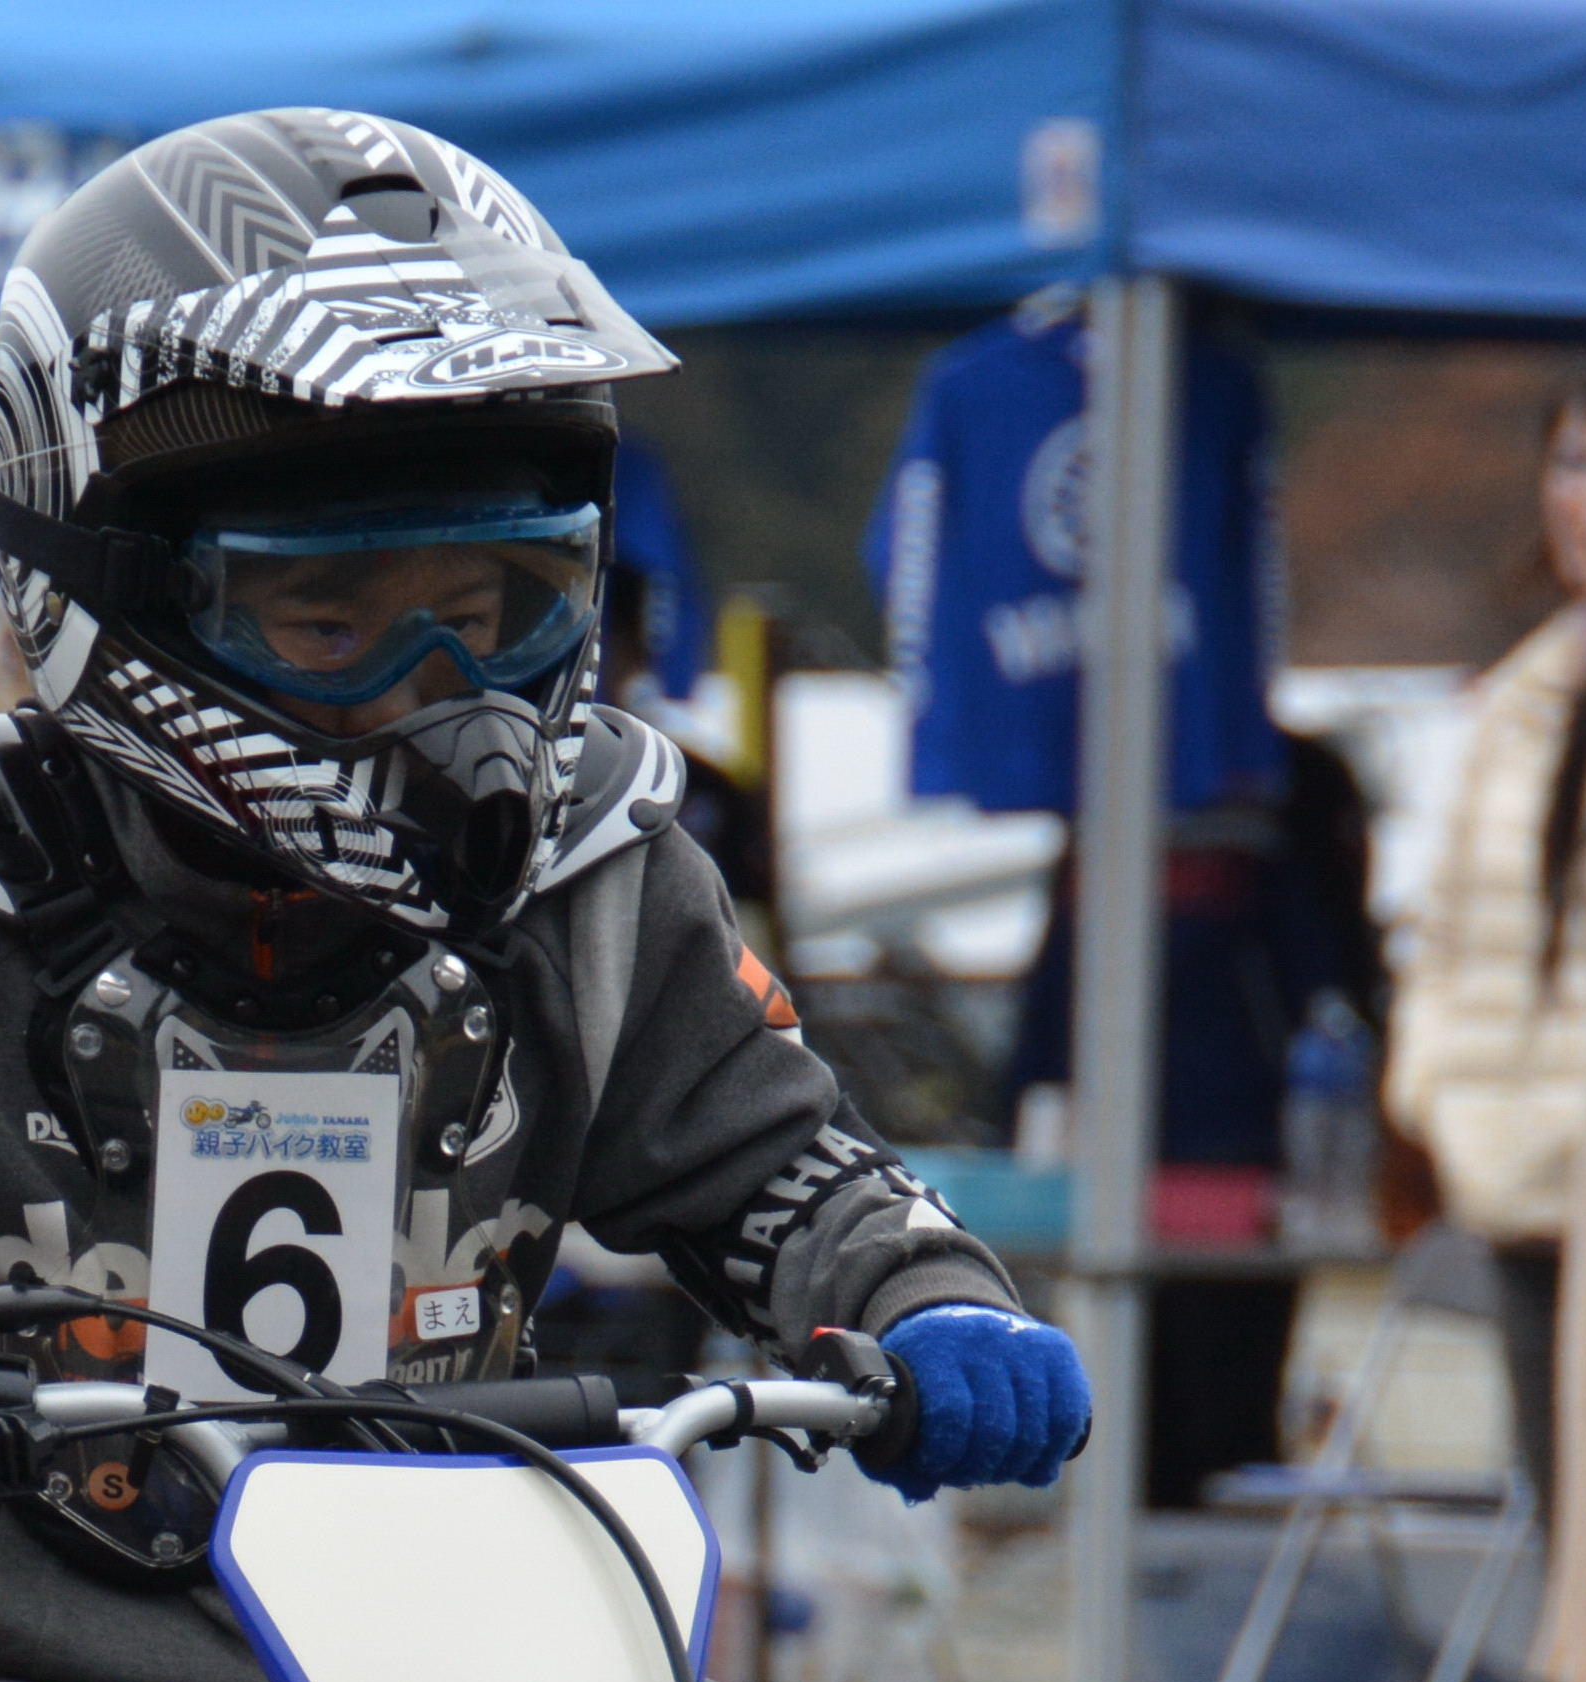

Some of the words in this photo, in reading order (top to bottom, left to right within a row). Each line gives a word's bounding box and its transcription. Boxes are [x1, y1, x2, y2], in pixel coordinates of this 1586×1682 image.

[450, 339, 587, 377] HJC
[194, 1129, 369, 1161] 親子バイク教室
[203, 1169, 344, 1395] 6
[423, 1296, 476, 1331] まえ
[102, 1473, 124, 1499] S
